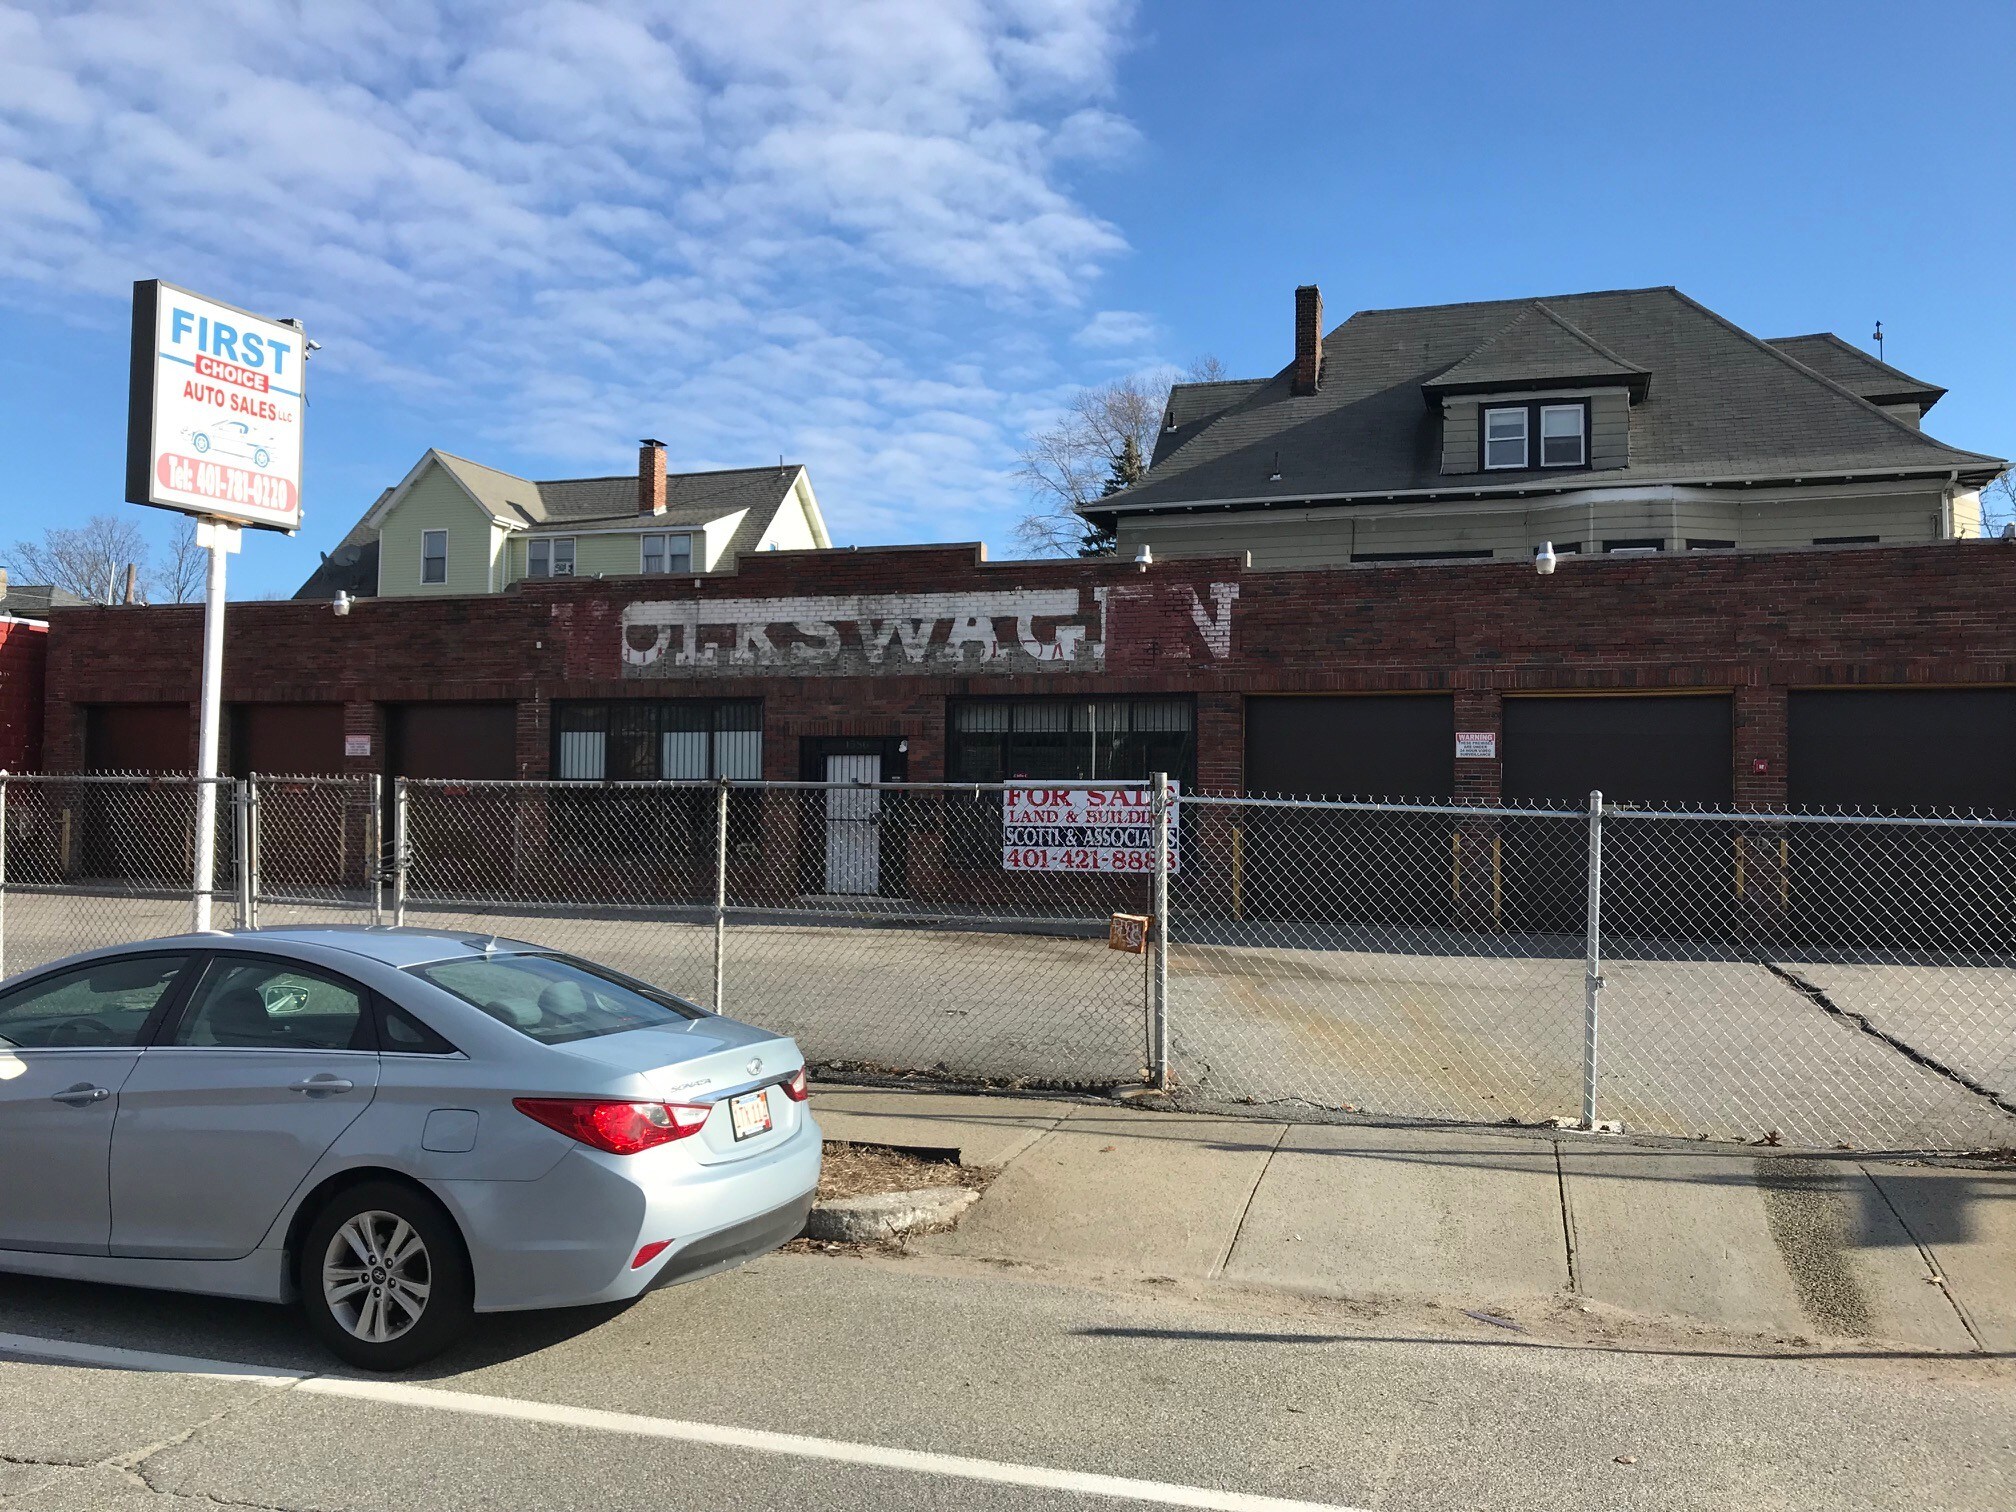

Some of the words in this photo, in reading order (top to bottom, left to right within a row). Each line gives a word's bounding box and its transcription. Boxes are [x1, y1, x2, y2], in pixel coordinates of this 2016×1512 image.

[172, 307, 290, 374] FIRST
[200, 358, 265, 390] CHOICE
[184, 380, 224, 407] AUTO
[231, 393, 276, 421] SALES
[278, 411, 292, 422] LLC
[197, 461, 288, 510] 401-781-0220
[1007, 788, 1072, 806] FOR
[1010, 810, 1058, 823] LAND
[1066, 811, 1078, 823] &
[1006, 828, 1059, 845] SCOTTI
[1065, 828, 1078, 846] &
[1083, 828, 1175, 847] ASSOCIAS
